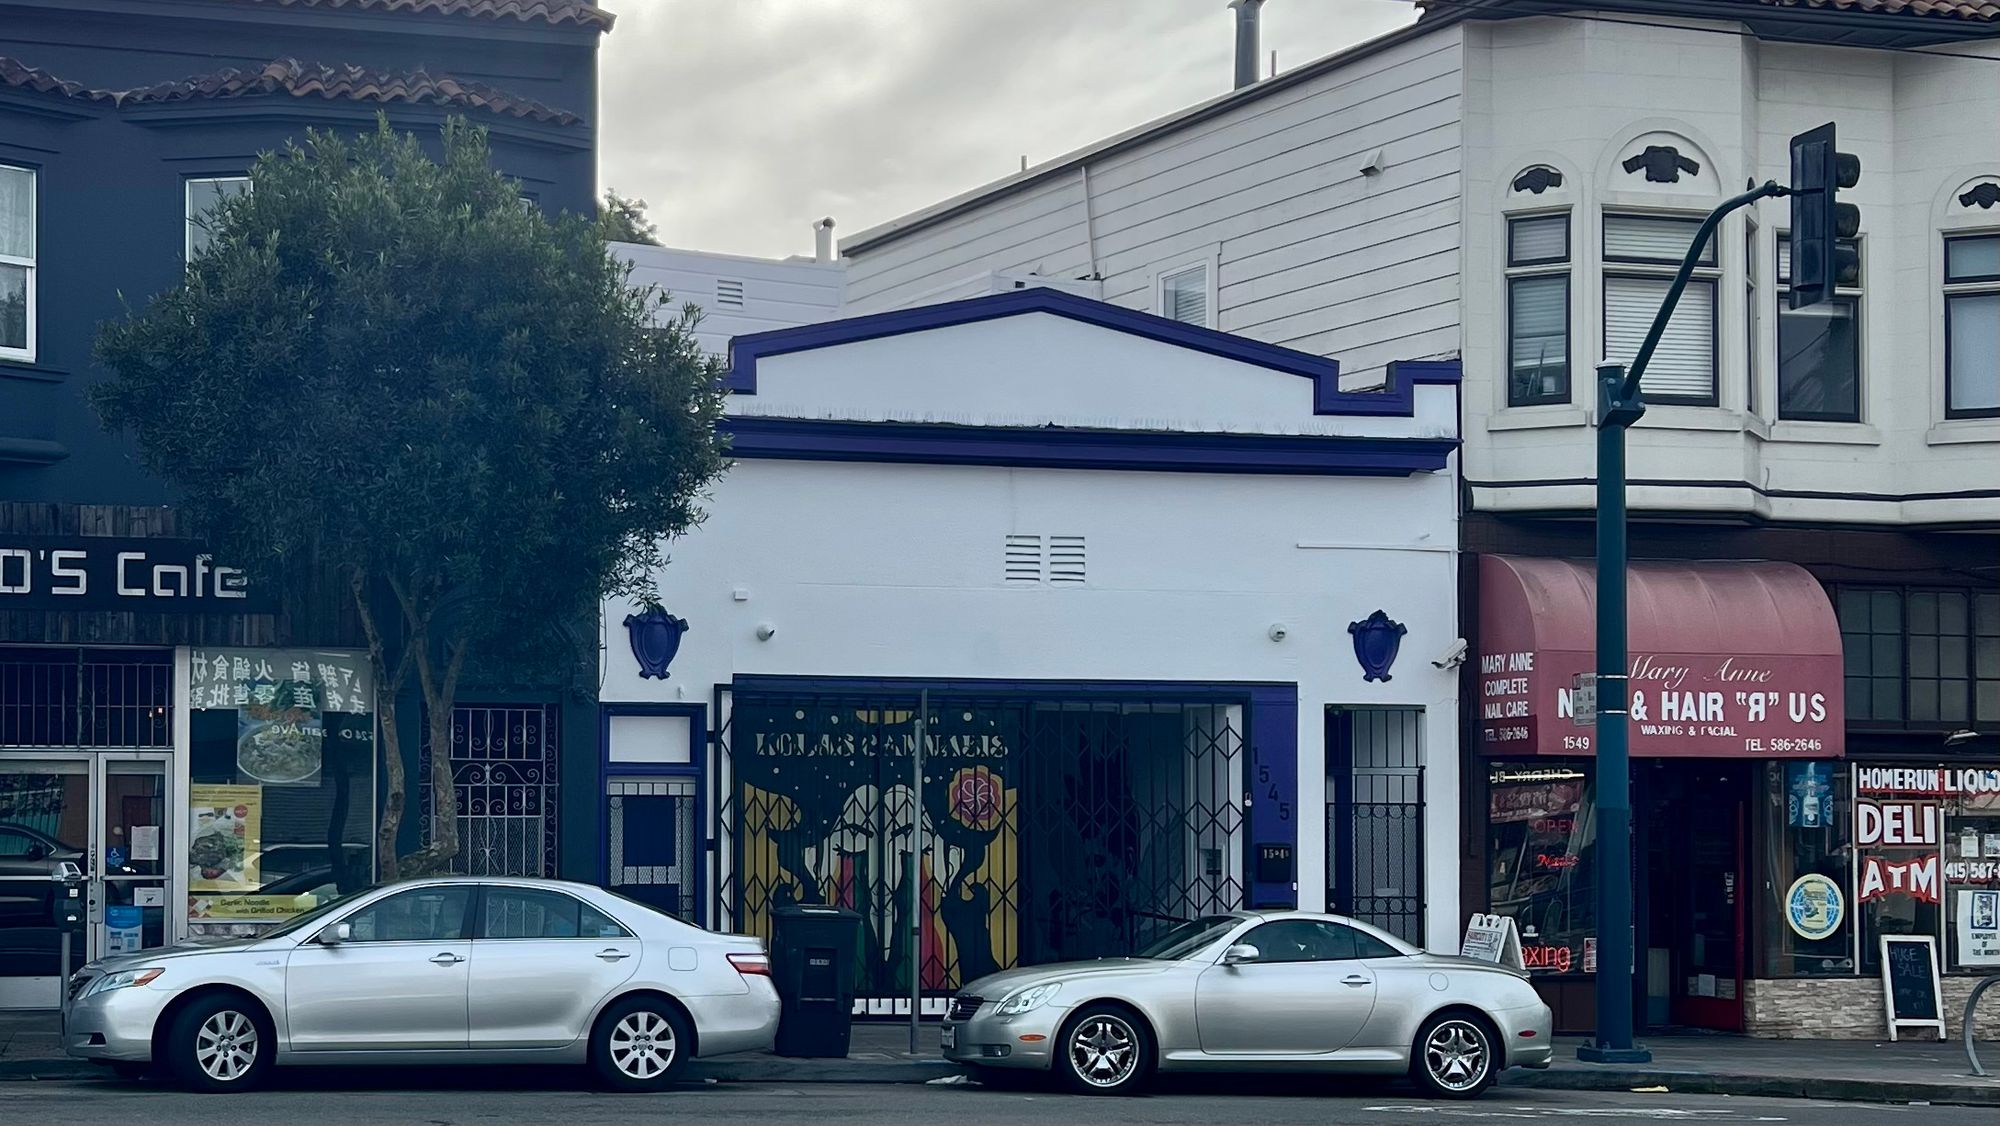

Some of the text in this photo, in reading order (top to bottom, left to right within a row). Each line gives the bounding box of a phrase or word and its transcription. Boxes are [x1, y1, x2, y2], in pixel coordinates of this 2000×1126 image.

[117, 551, 248, 598] Cafe
[1481, 652, 1533, 674] MARY ANNE
[1630, 655, 1774, 689] Mary Anne
[1485, 678, 1528, 696] COMPLETE
[1485, 701, 1529, 719] NAIL CARE
[1631, 690, 1648, 721] &
[1661, 691, 1724, 721] HAIR
[1788, 692, 1826, 723] US
[1641, 725, 1738, 736] WAXING & FACIAL
[1563, 736, 1590, 749] 1549
[1770, 738, 1821, 751] 586-2646
[1859, 768, 1940, 791] HOMERUN
[1858, 803, 1936, 844] DELI
[1862, 857, 1938, 899] ATM
[1970, 862, 2000, 879] 587-
